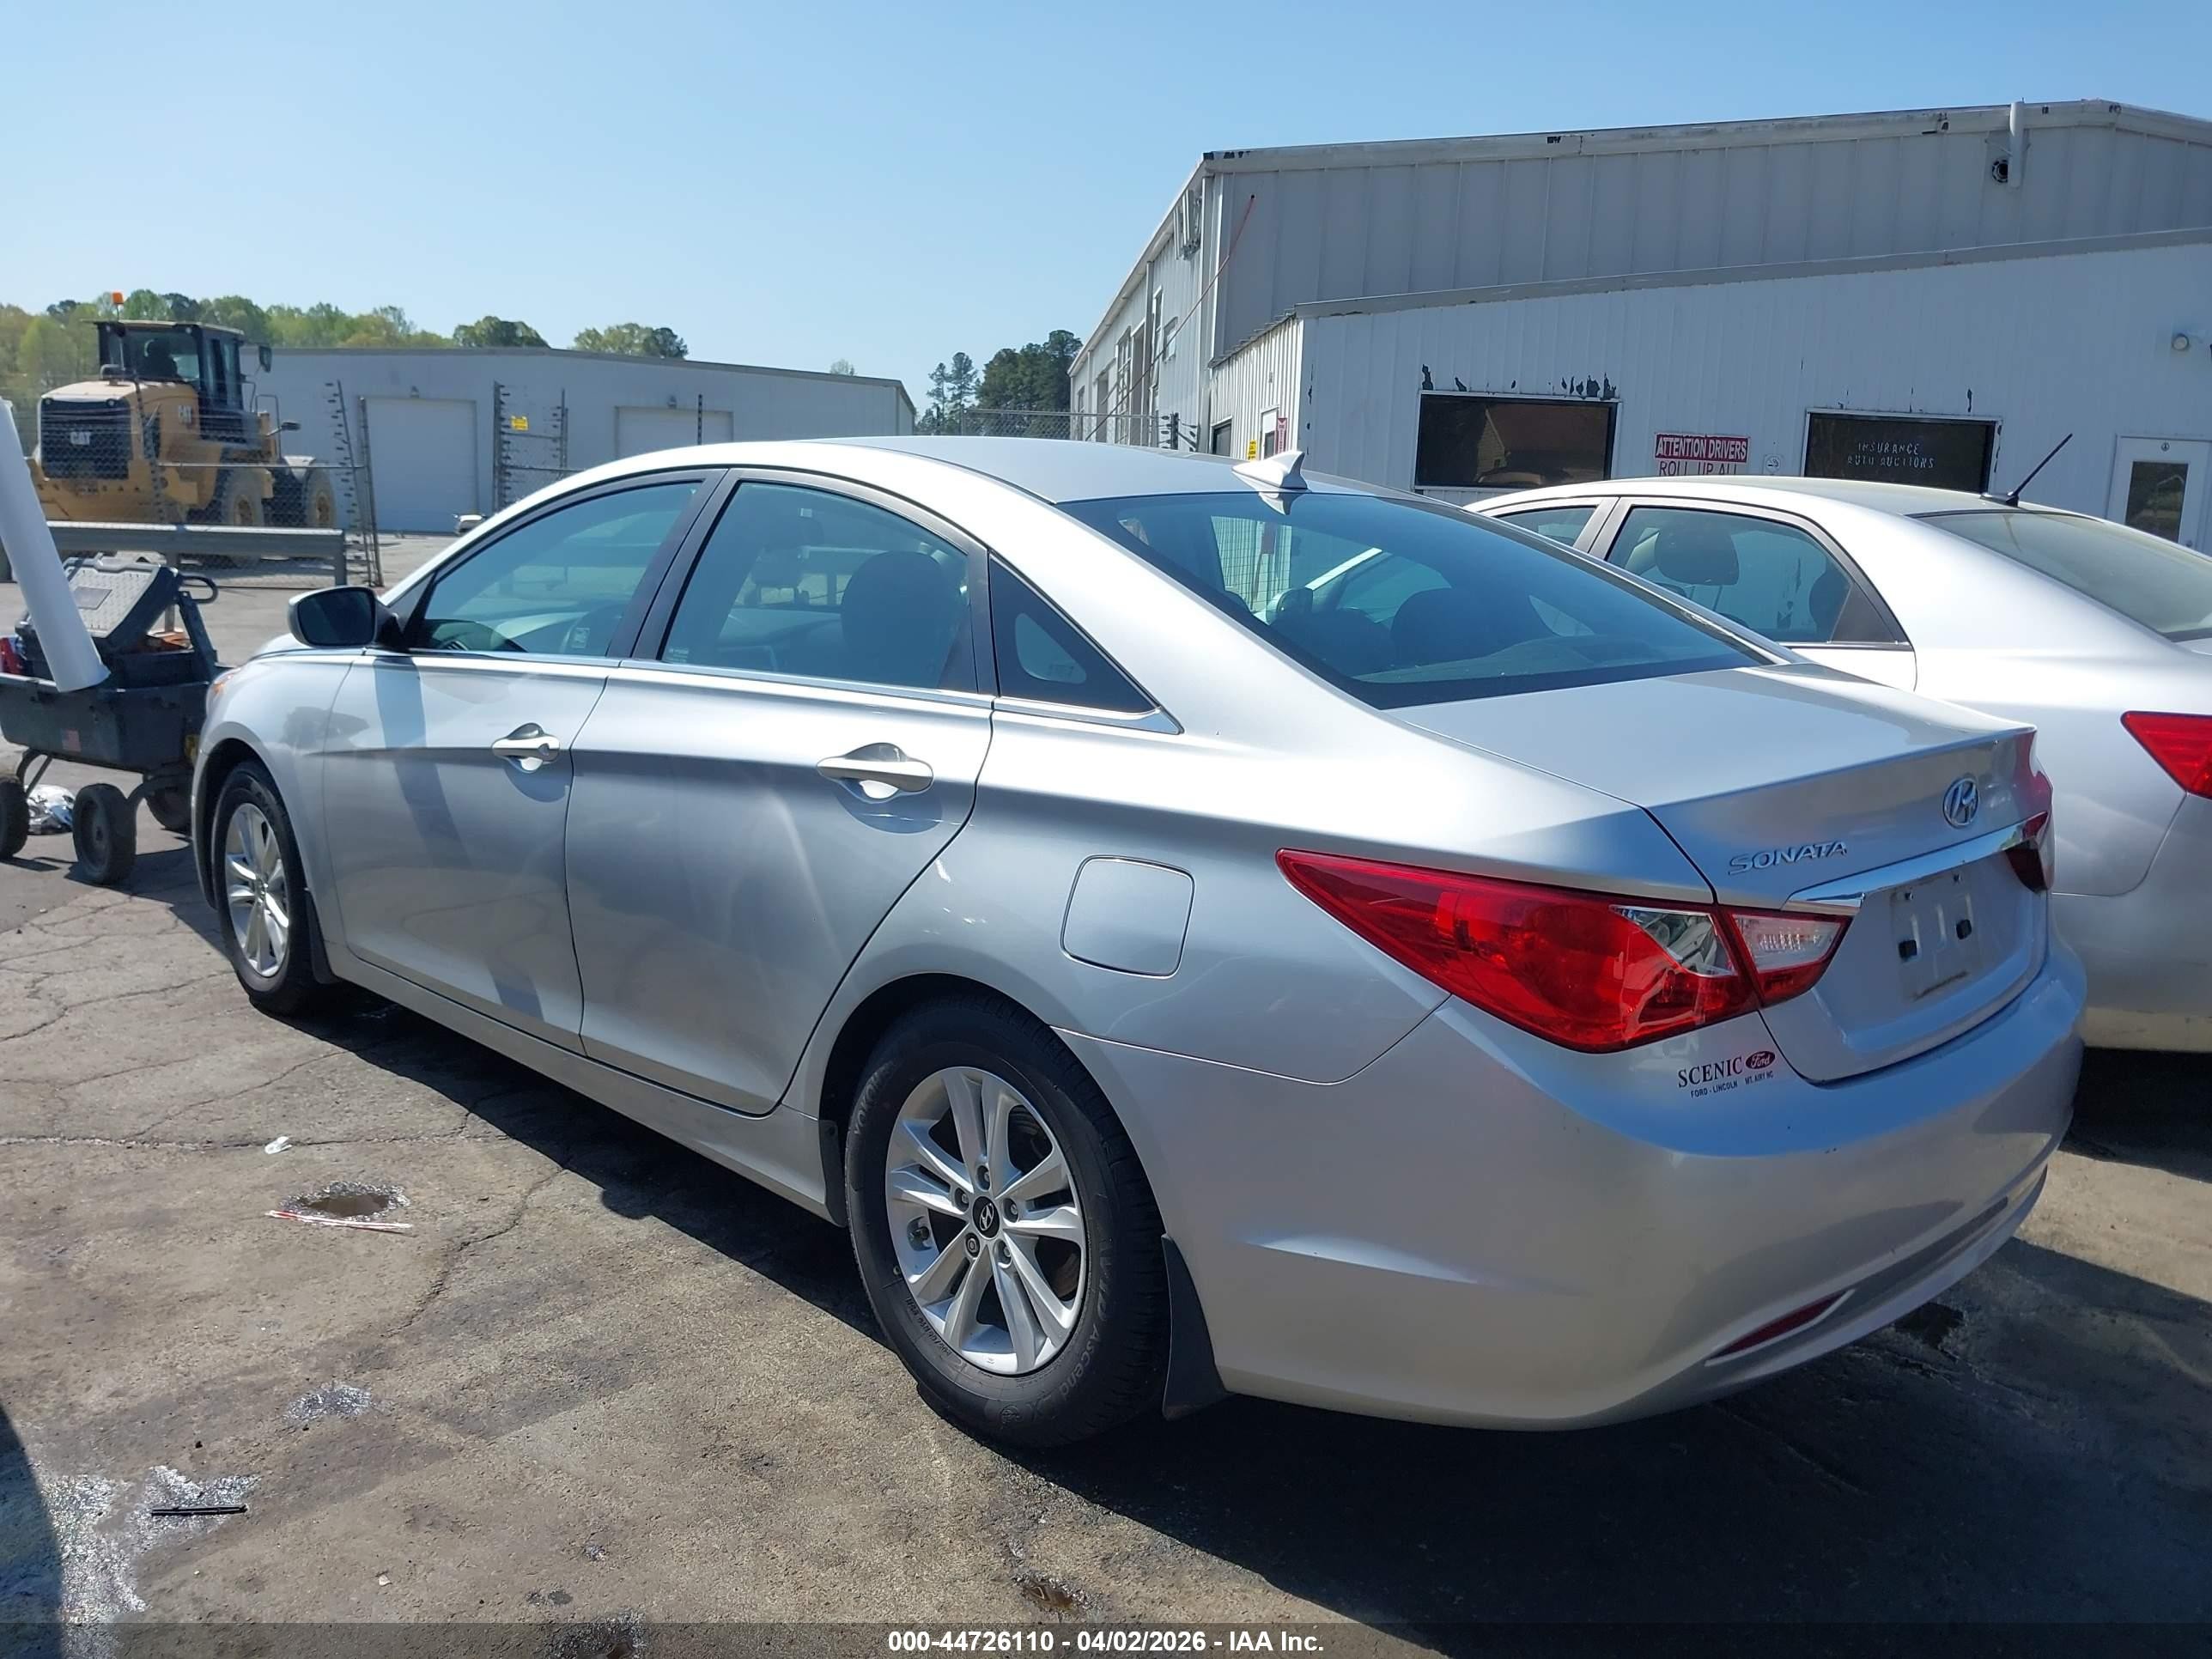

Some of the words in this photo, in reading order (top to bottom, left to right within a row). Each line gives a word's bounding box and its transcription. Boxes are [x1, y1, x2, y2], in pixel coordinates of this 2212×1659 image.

[70, 431, 91, 445] CAT
[1857, 441, 1920, 455] INSURANCE
[1656, 438, 1707, 459] ATTENTION
[1708, 441, 1747, 460] DRIVERS
[1728, 841, 1848, 876] SONATA
[1677, 1056, 1743, 1089] SCENIC
[1749, 1052, 1772, 1068] Ford
[1690, 1087, 1709, 1100] FORD
[1712, 1079, 1738, 1094] LINCOLN
